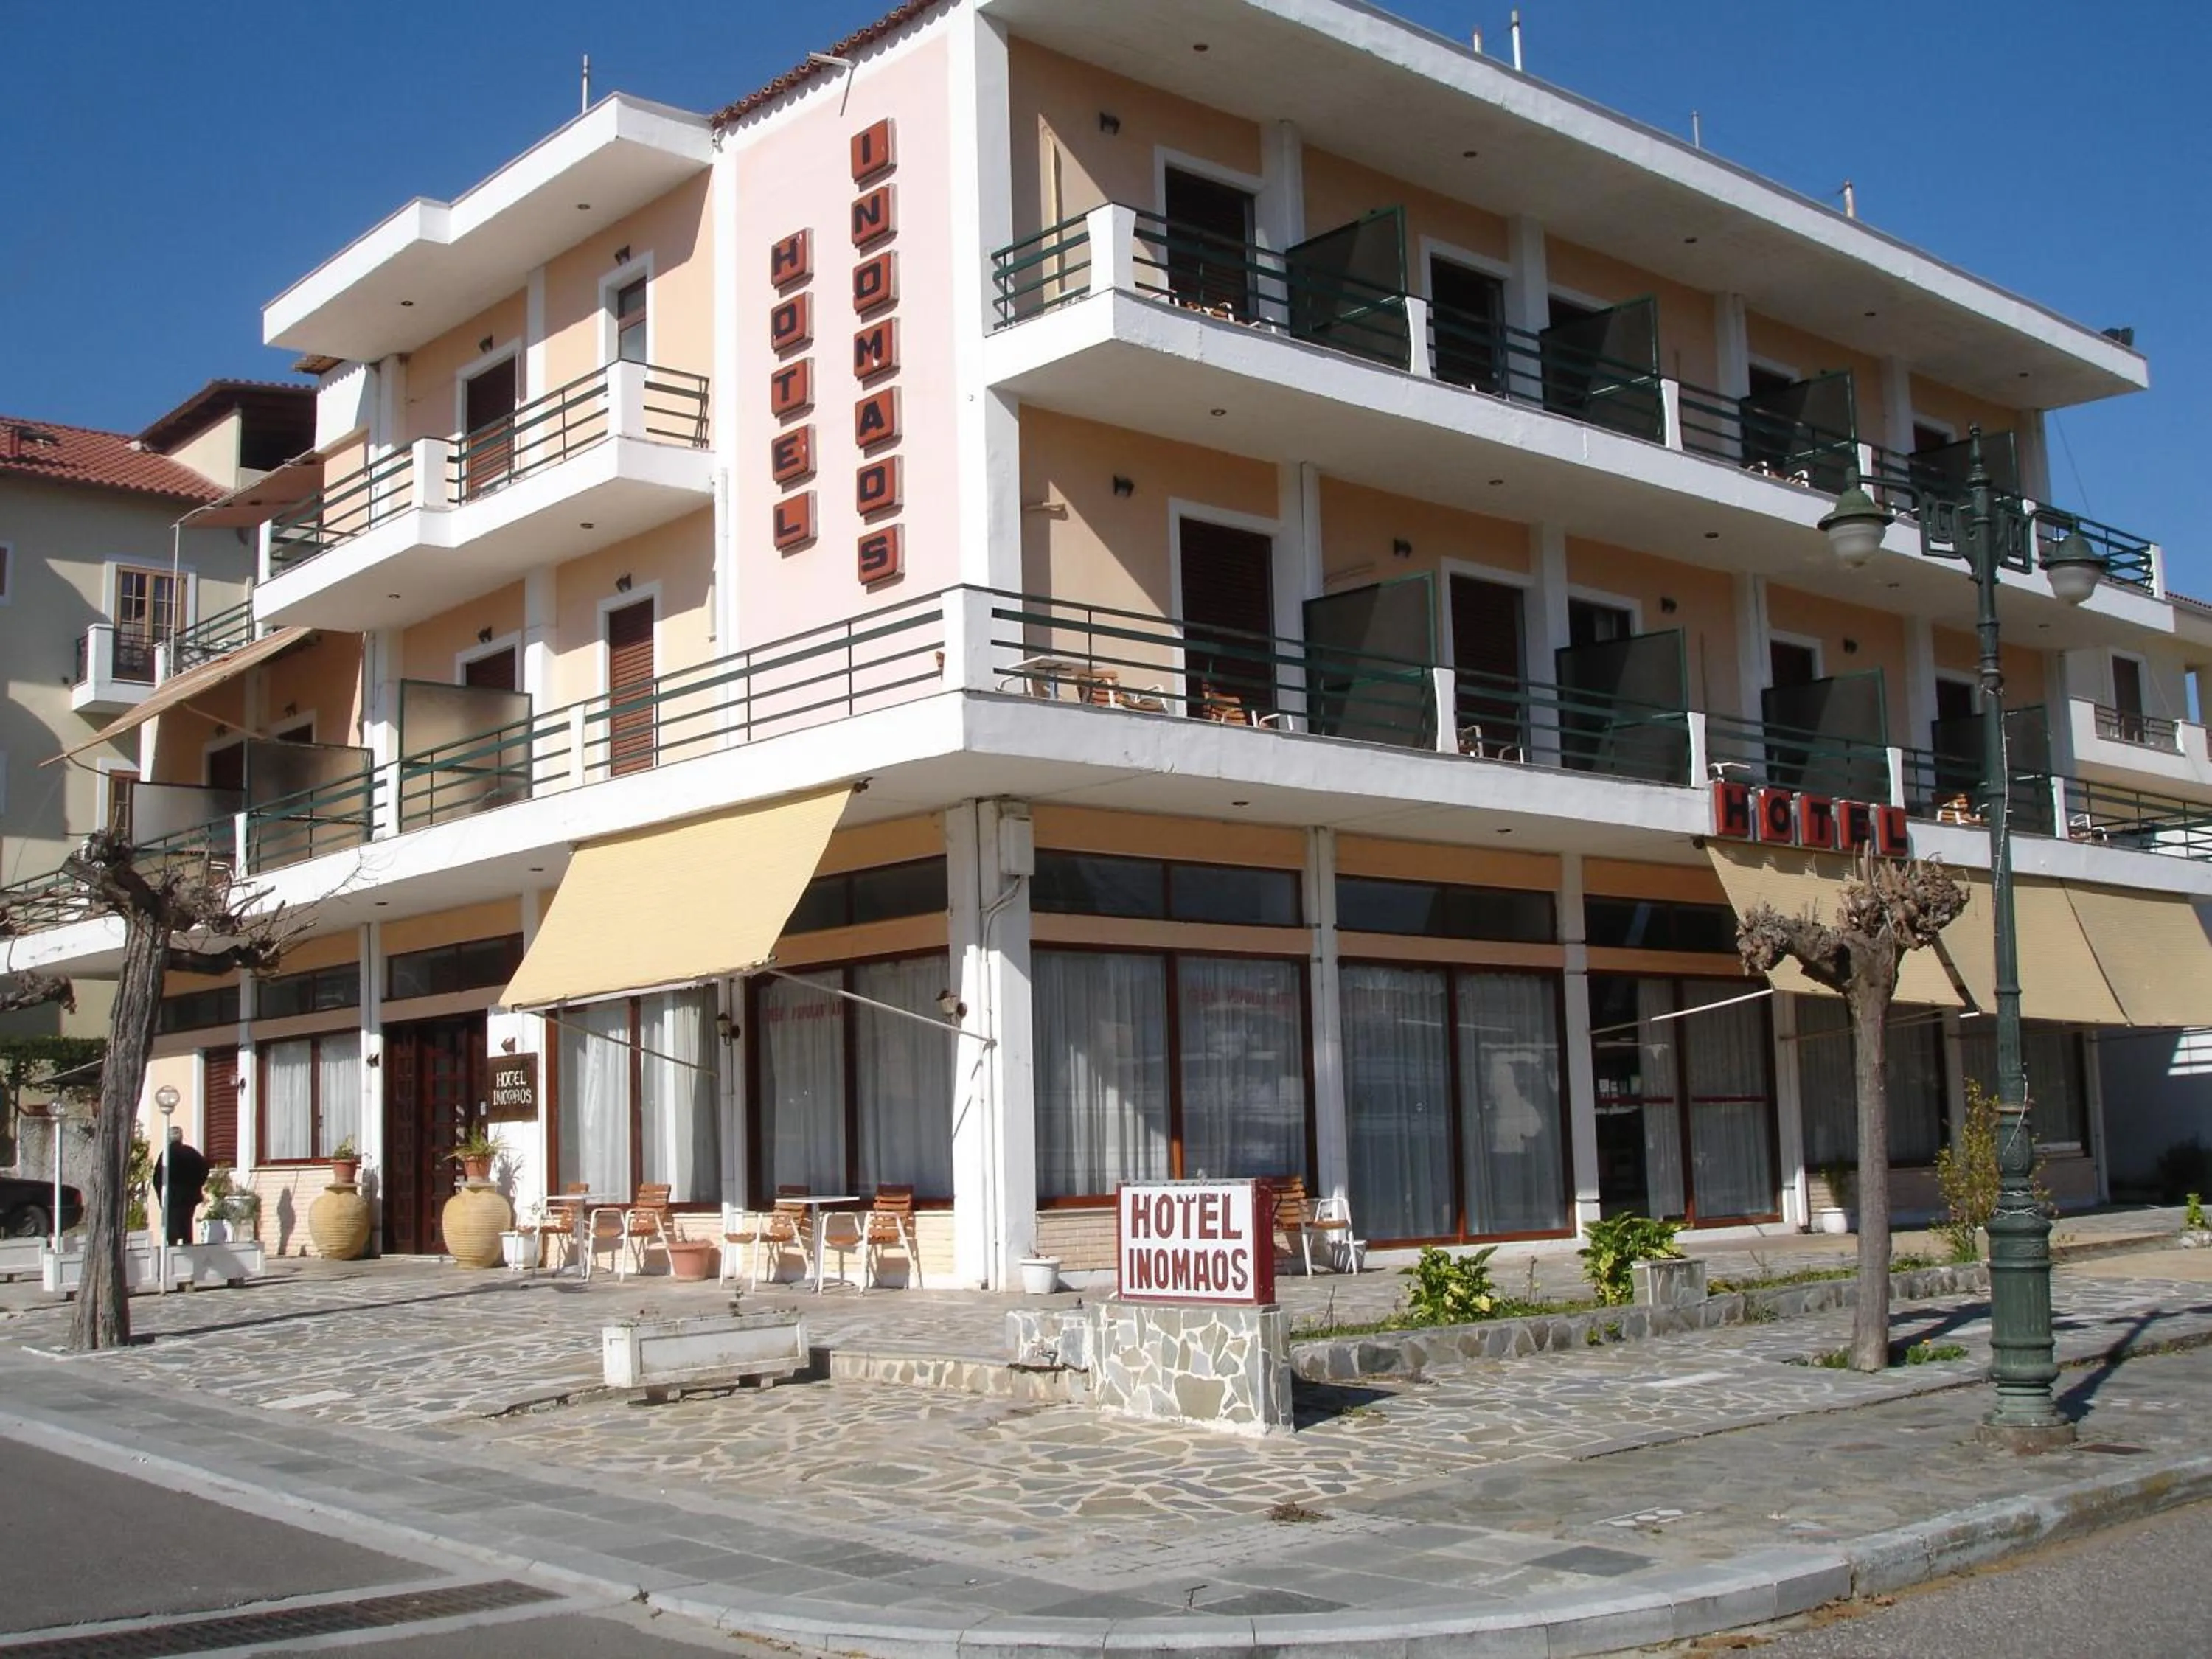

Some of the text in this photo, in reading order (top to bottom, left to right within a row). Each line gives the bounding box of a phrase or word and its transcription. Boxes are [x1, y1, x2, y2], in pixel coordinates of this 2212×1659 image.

[853, 133, 888, 571] INOMAOS
[771, 237, 801, 538] HOTEL
[1724, 788, 1908, 849] HOTEL
[495, 1070, 526, 1088] HOTEL
[1131, 1192, 1242, 1239] HOTEL
[1128, 1248, 1248, 1292] INOMAOS
